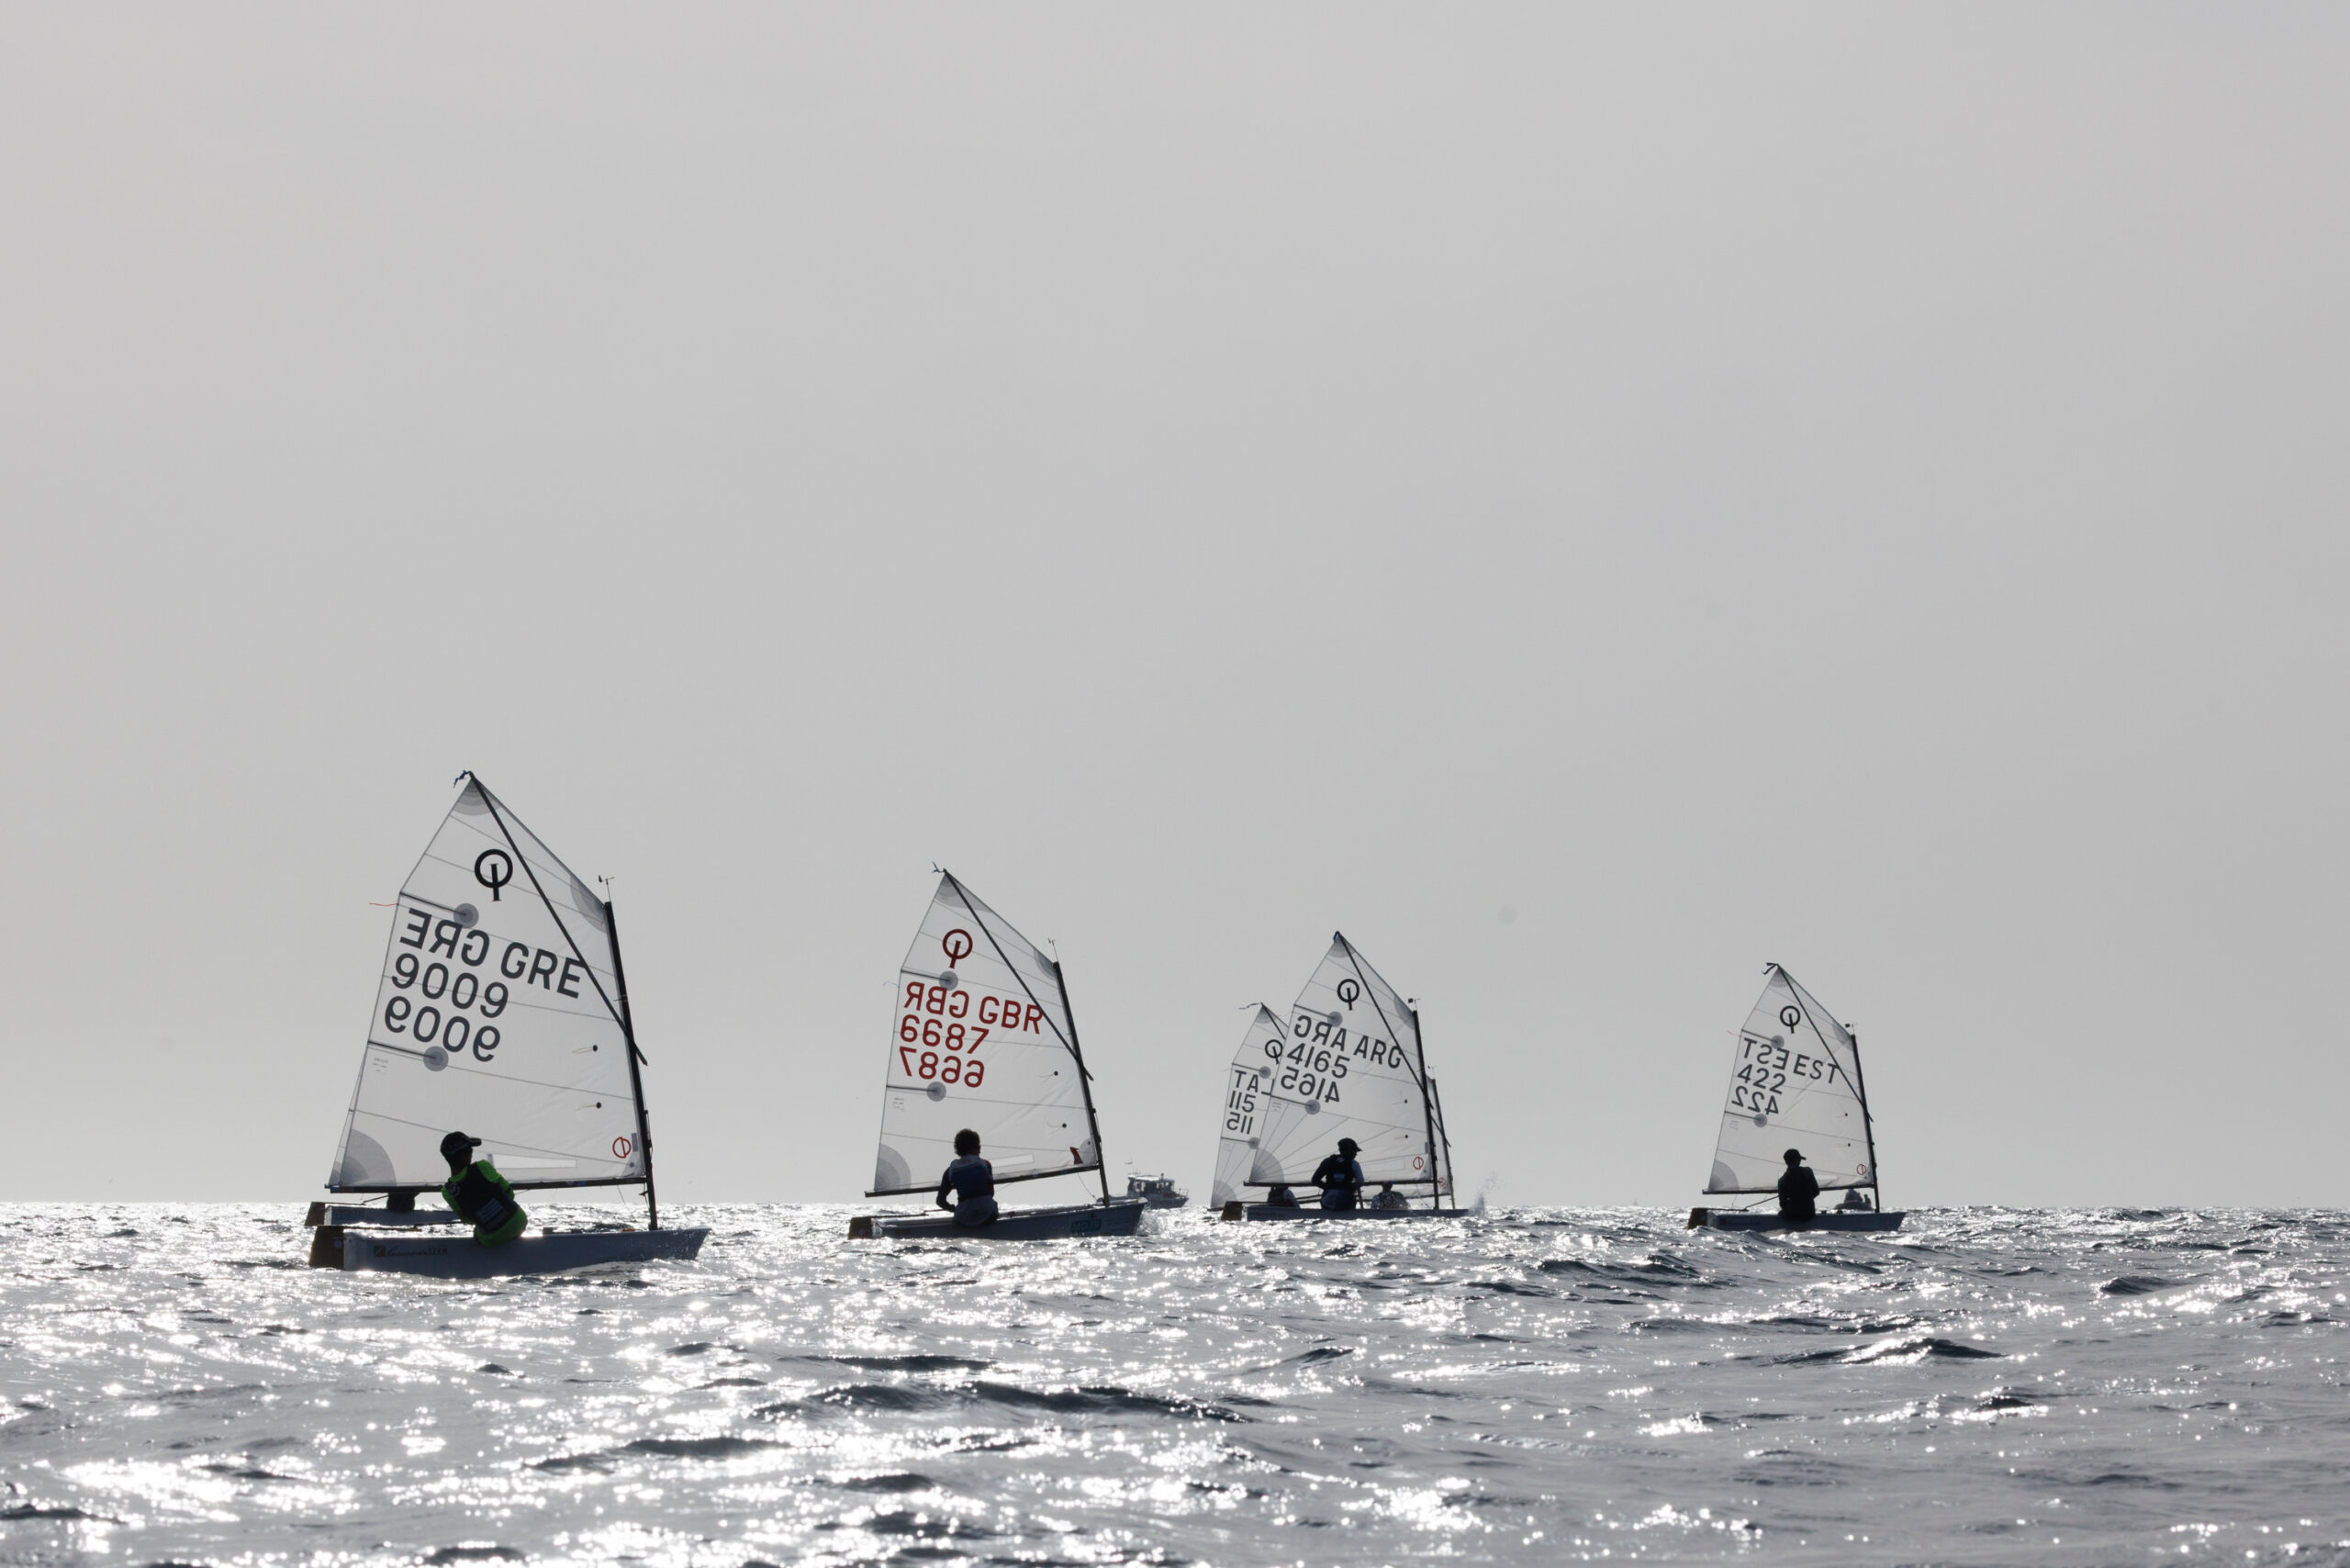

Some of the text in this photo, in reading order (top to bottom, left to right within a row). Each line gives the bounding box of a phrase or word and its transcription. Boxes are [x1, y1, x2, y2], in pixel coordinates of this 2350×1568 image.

[391, 952, 509, 1019] 9009
[500, 941, 586, 999] GRE
[979, 995, 1043, 1035] GBR
[900, 1014, 990, 1055] 6687
[1353, 1035, 1404, 1070] ARG
[1287, 1042, 1350, 1079] 4165
[1737, 1063, 1786, 1095] 422
[1793, 1053, 1840, 1084] EST
[1228, 1090, 1257, 1114] 115
